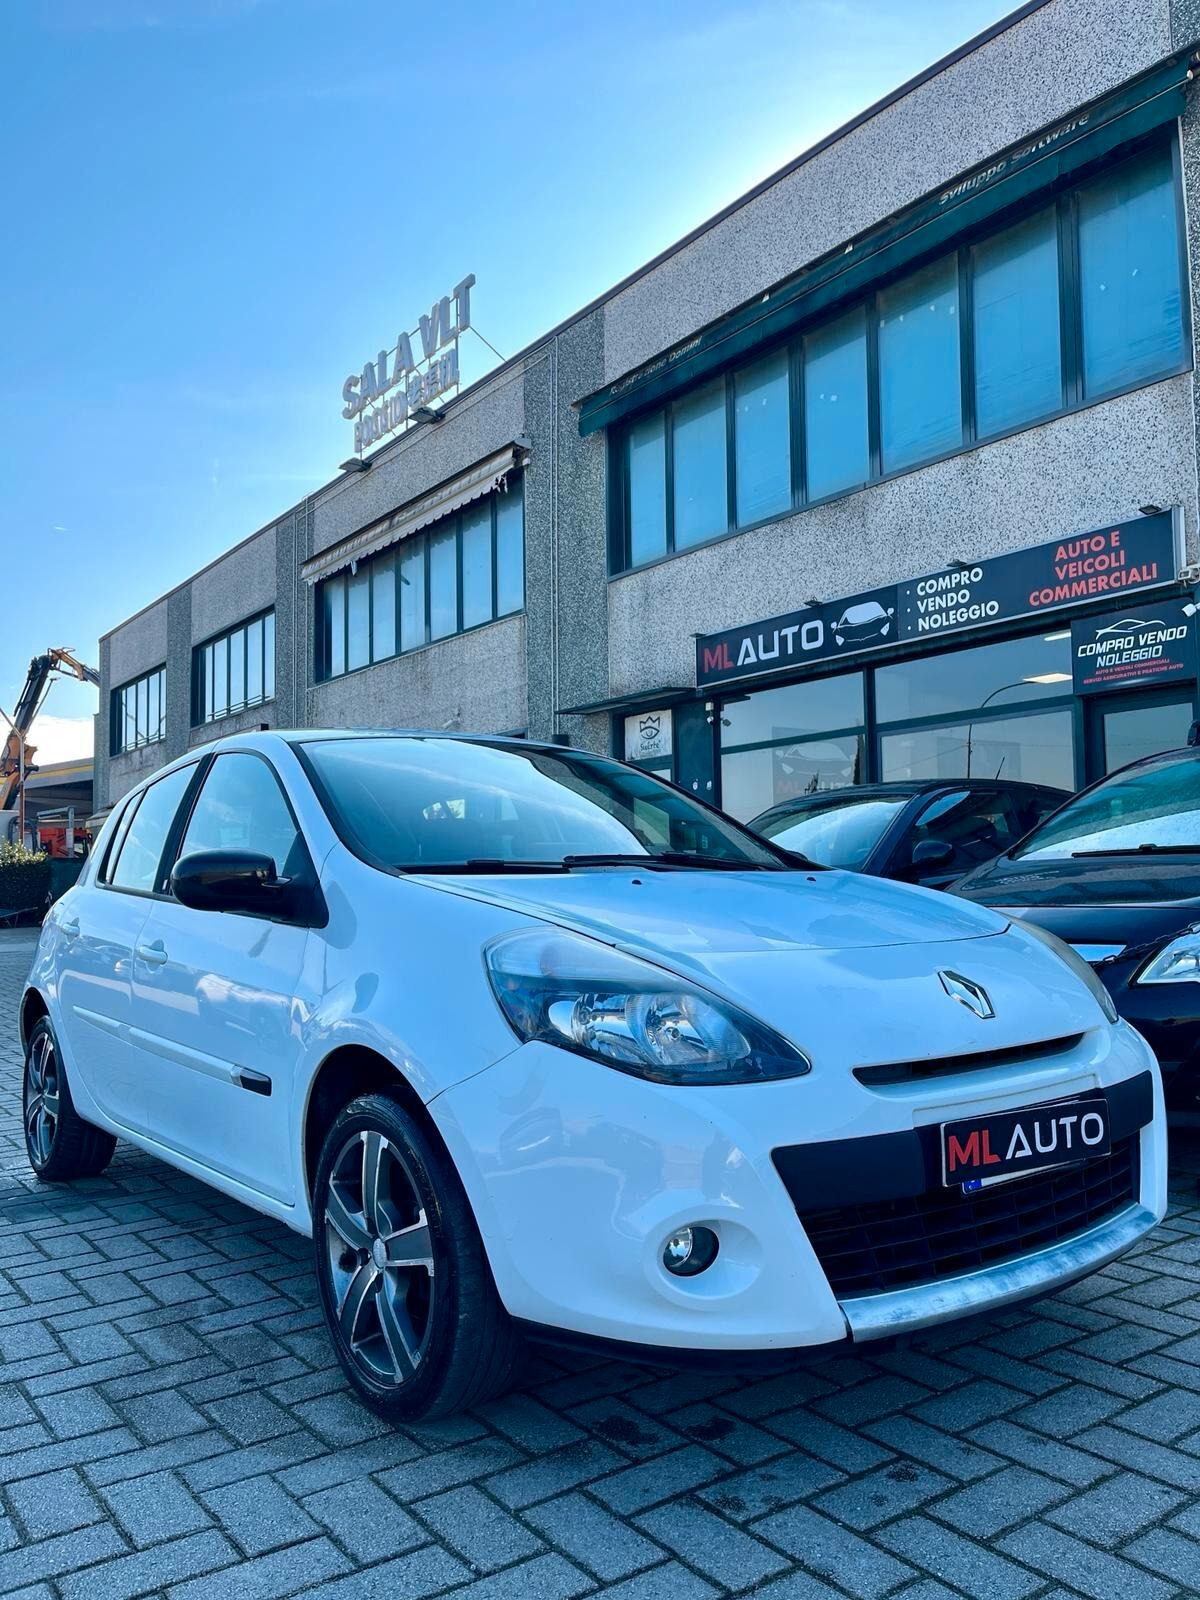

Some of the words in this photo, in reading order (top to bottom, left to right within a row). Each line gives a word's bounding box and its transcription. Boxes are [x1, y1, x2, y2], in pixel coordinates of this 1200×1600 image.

[938, 160, 1007, 206] Sviluppo
[342, 331, 415, 420] SALA
[418, 273, 476, 359] VLT
[1055, 535, 1106, 561] AUTO
[1110, 530, 1120, 547] E
[1055, 550, 1125, 580] VEICOLI
[917, 567, 983, 596] COMPRO
[1029, 563, 1158, 606] COMMERCIALI
[917, 589, 970, 613] VENDO
[918, 601, 999, 632] NOLEGGIO
[736, 620, 824, 666] AUTO
[1078, 636, 1134, 657] COMPRO
[1138, 625, 1188, 646] VENDO
[1096, 645, 1163, 668] NOLEGGIO
[948, 1129, 1002, 1172] ML
[1005, 1112, 1104, 1160] AUTO
